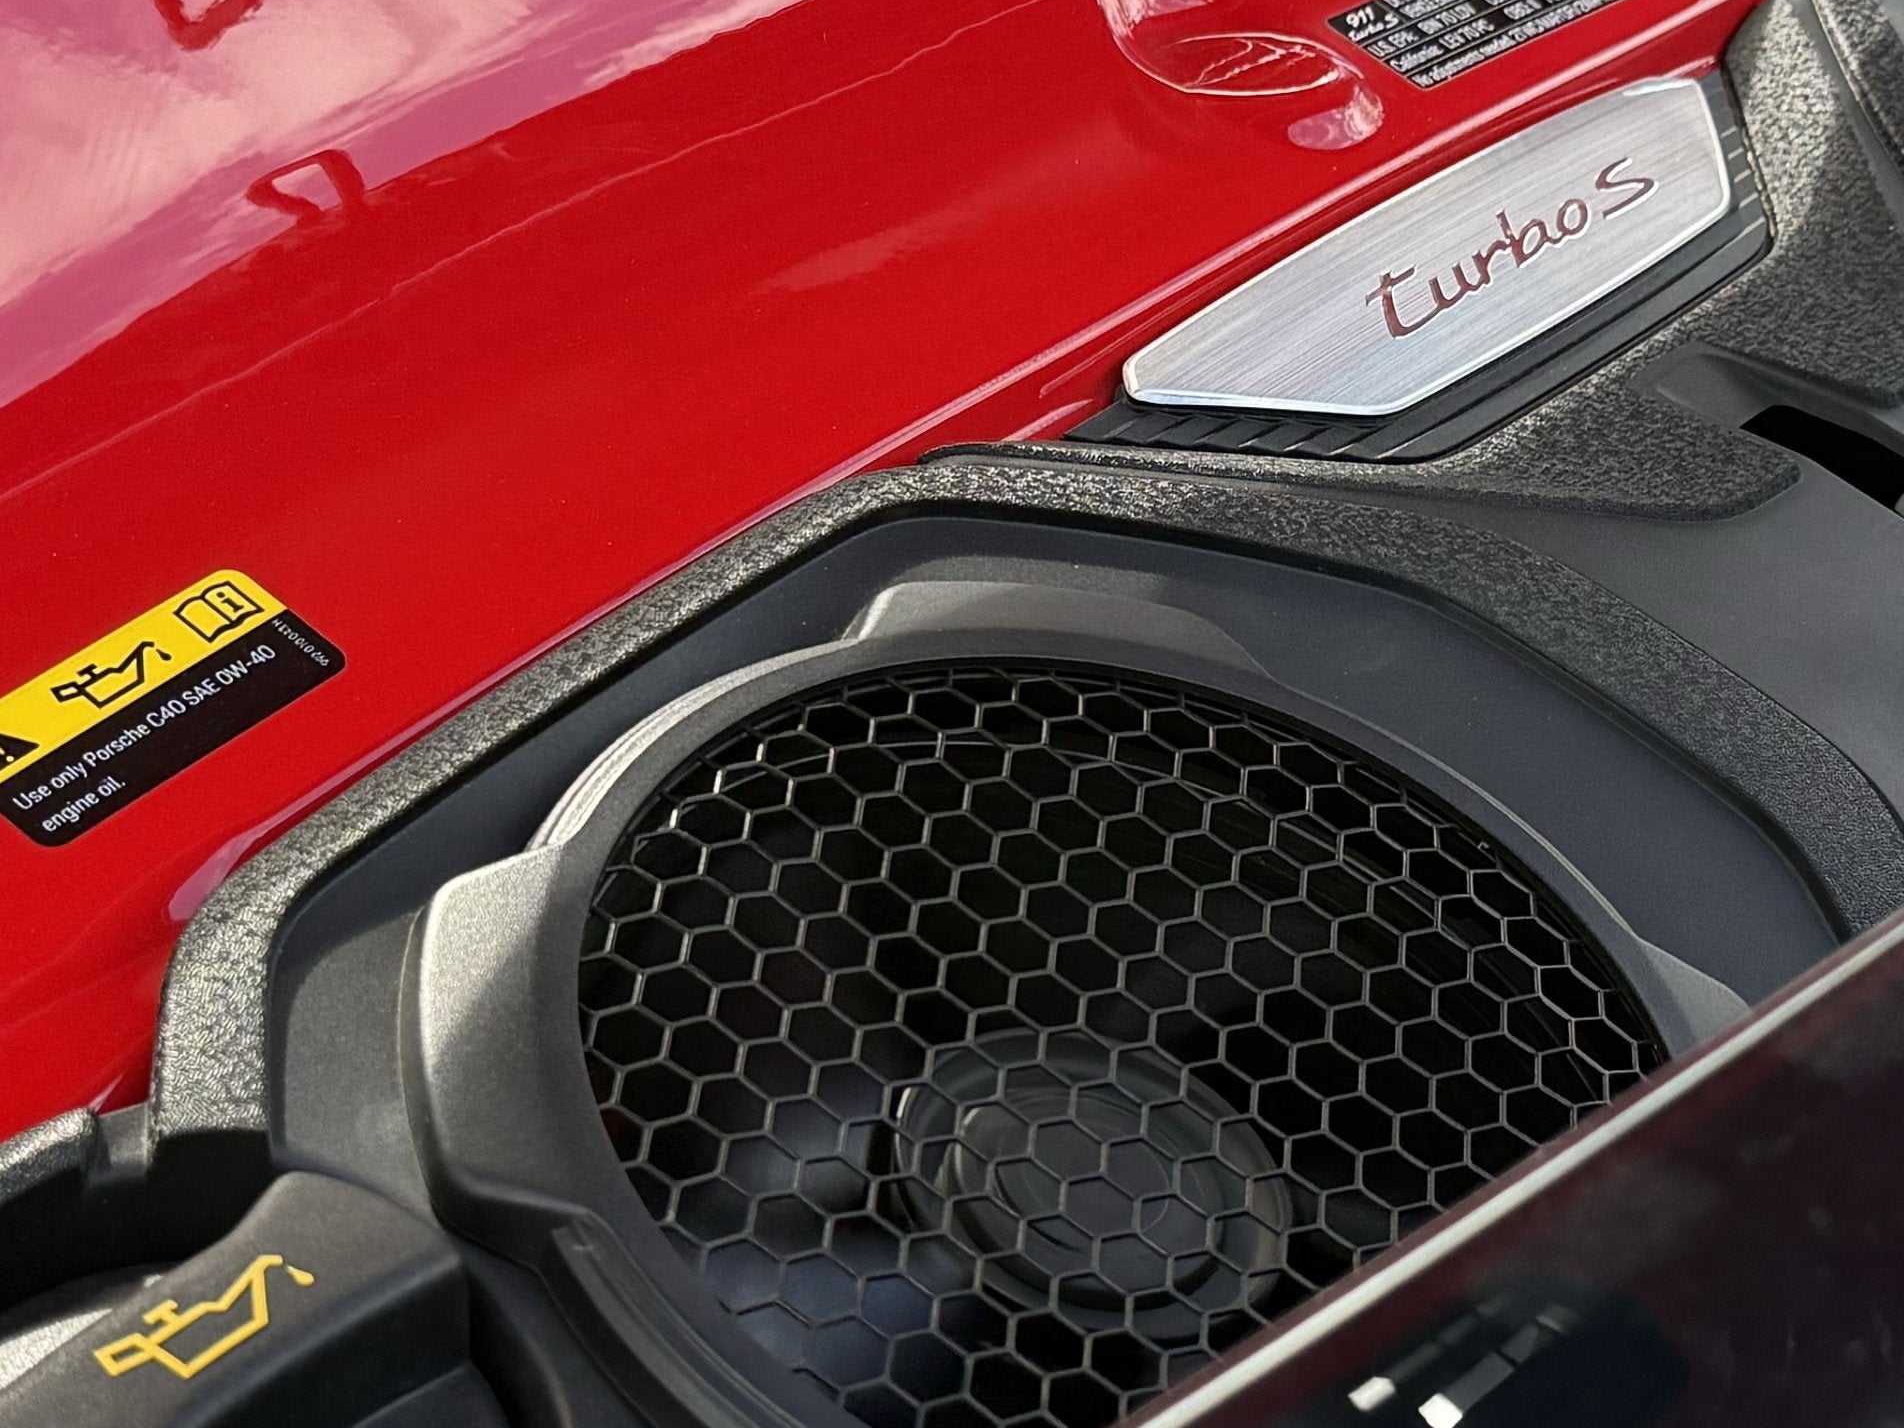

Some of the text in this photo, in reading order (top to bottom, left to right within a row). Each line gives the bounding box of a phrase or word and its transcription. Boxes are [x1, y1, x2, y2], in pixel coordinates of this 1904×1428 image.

[1346, 6, 1374, 28] 911
[1384, 13, 1398, 29] S
[1594, 156, 1658, 220] S
[12, 643, 277, 811] Use only Porsche C40 SAE 0W-40
[41, 776, 127, 833] engine oil.
